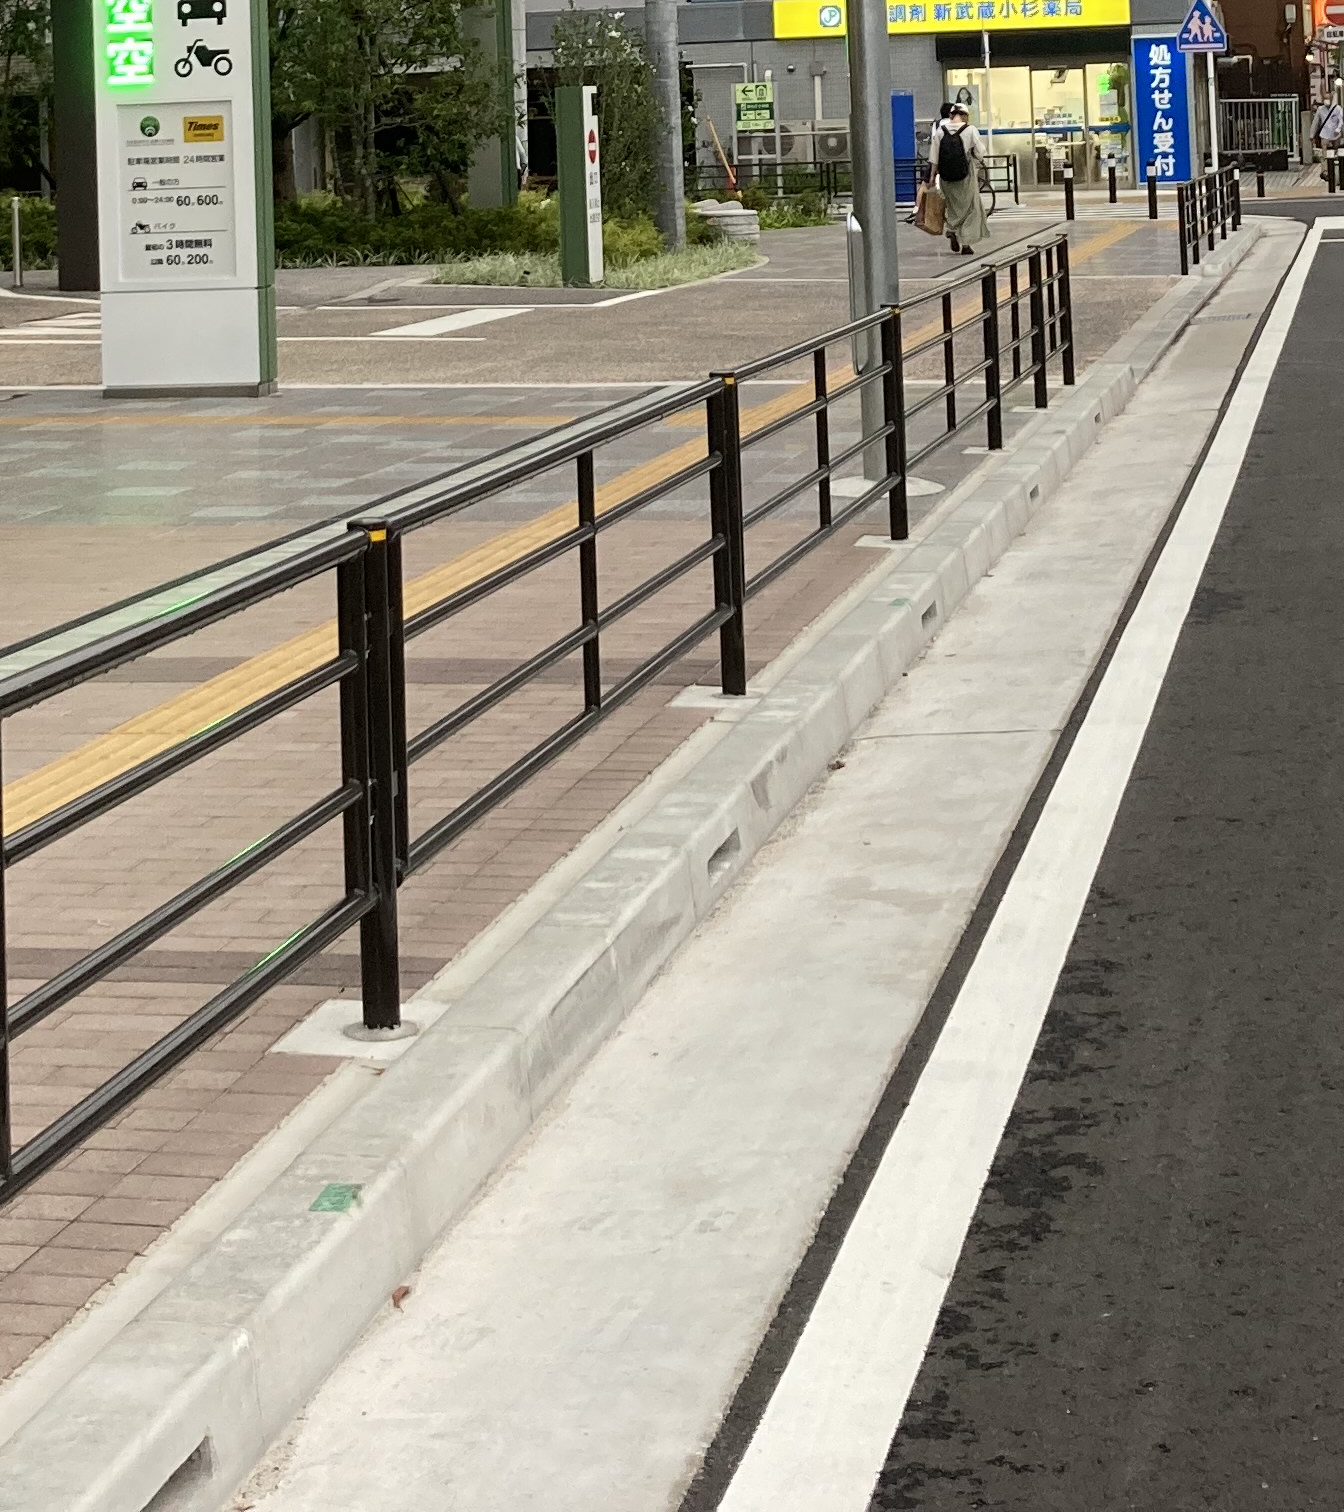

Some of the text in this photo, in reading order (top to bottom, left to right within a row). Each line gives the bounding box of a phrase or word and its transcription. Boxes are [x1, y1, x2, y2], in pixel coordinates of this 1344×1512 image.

[107, 37, 155, 86] 空
[187, 121, 220, 131] Times
[1148, 44, 1175, 178] 処方せん受付
